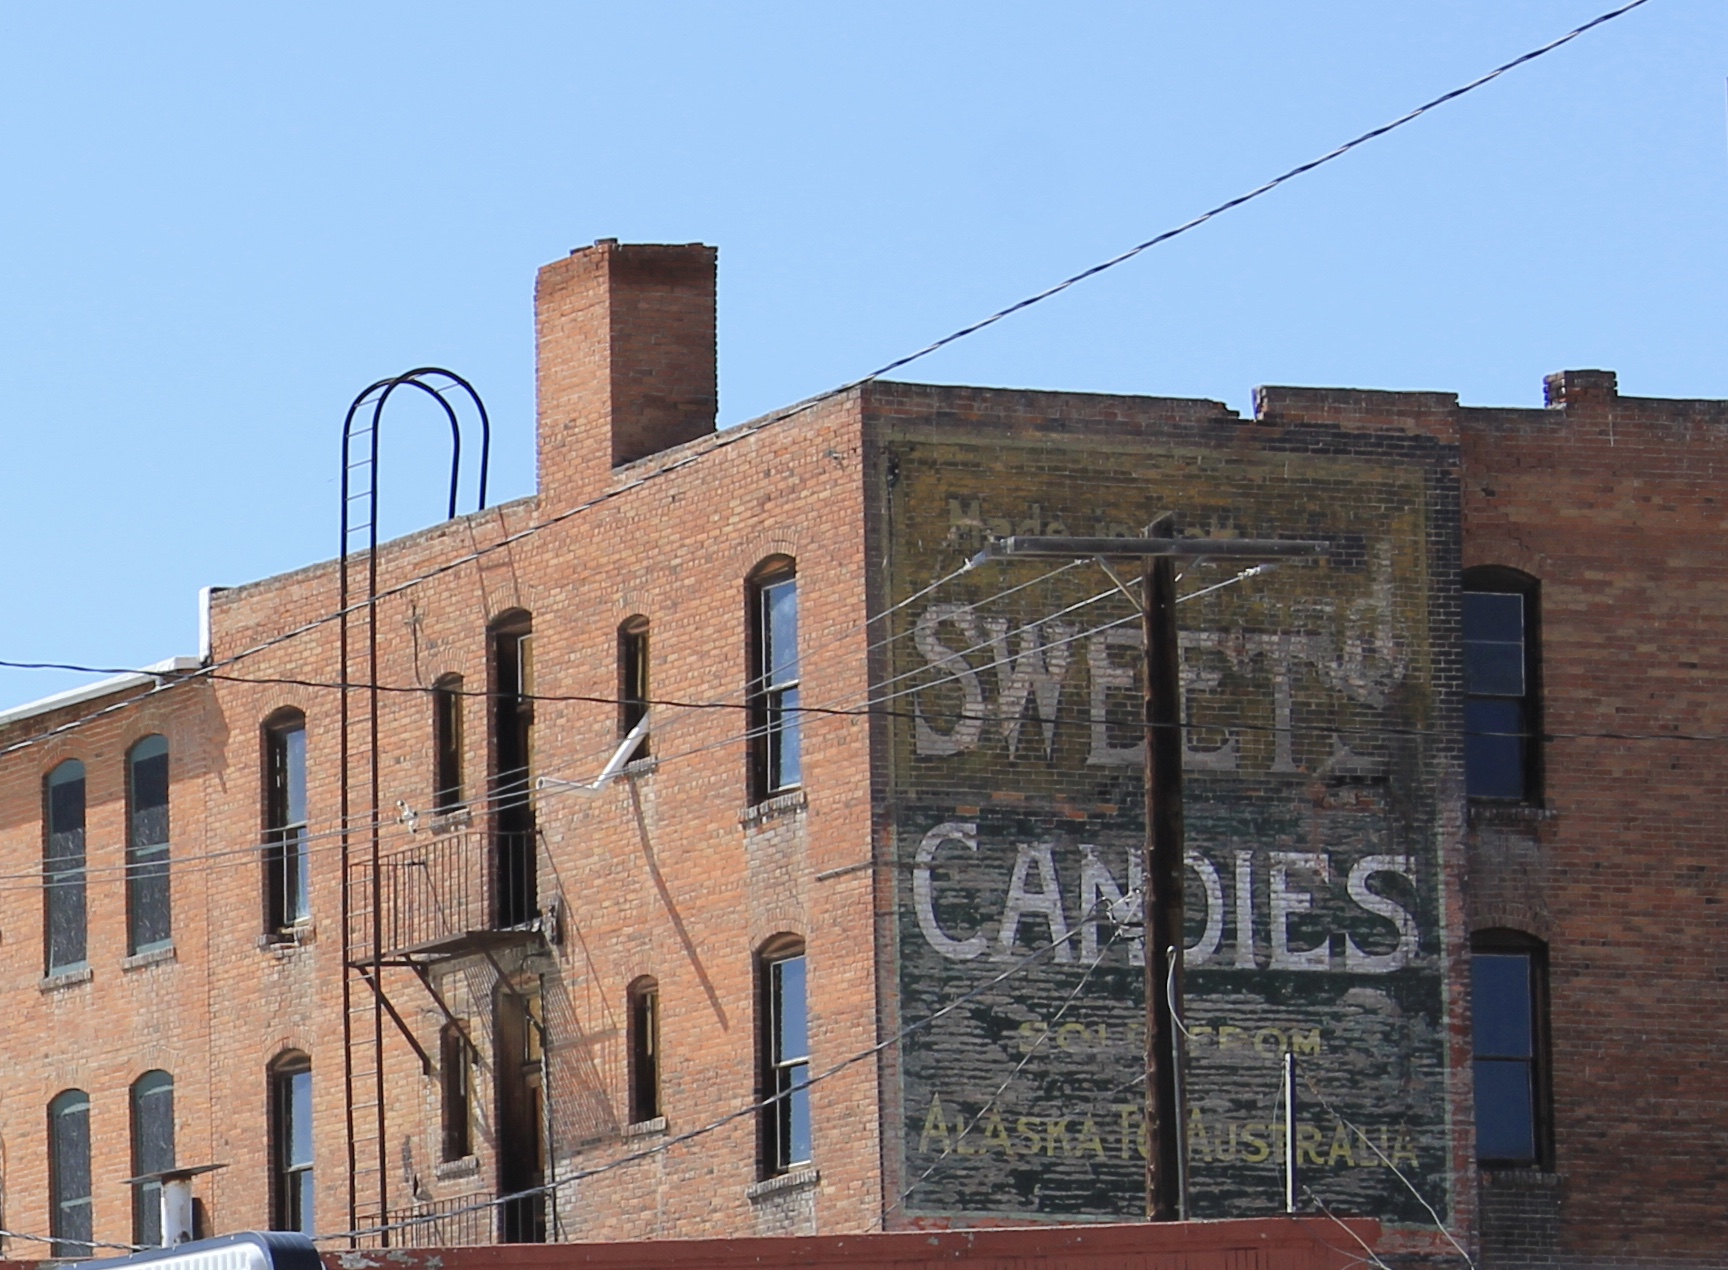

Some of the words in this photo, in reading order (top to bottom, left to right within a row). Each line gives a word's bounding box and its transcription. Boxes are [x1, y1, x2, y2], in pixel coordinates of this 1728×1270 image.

[912, 823, 1420, 975] CANDIES
[918, 1092, 1106, 1158] ALASKA
[1187, 1107, 1420, 1168] AUSTRALIA
